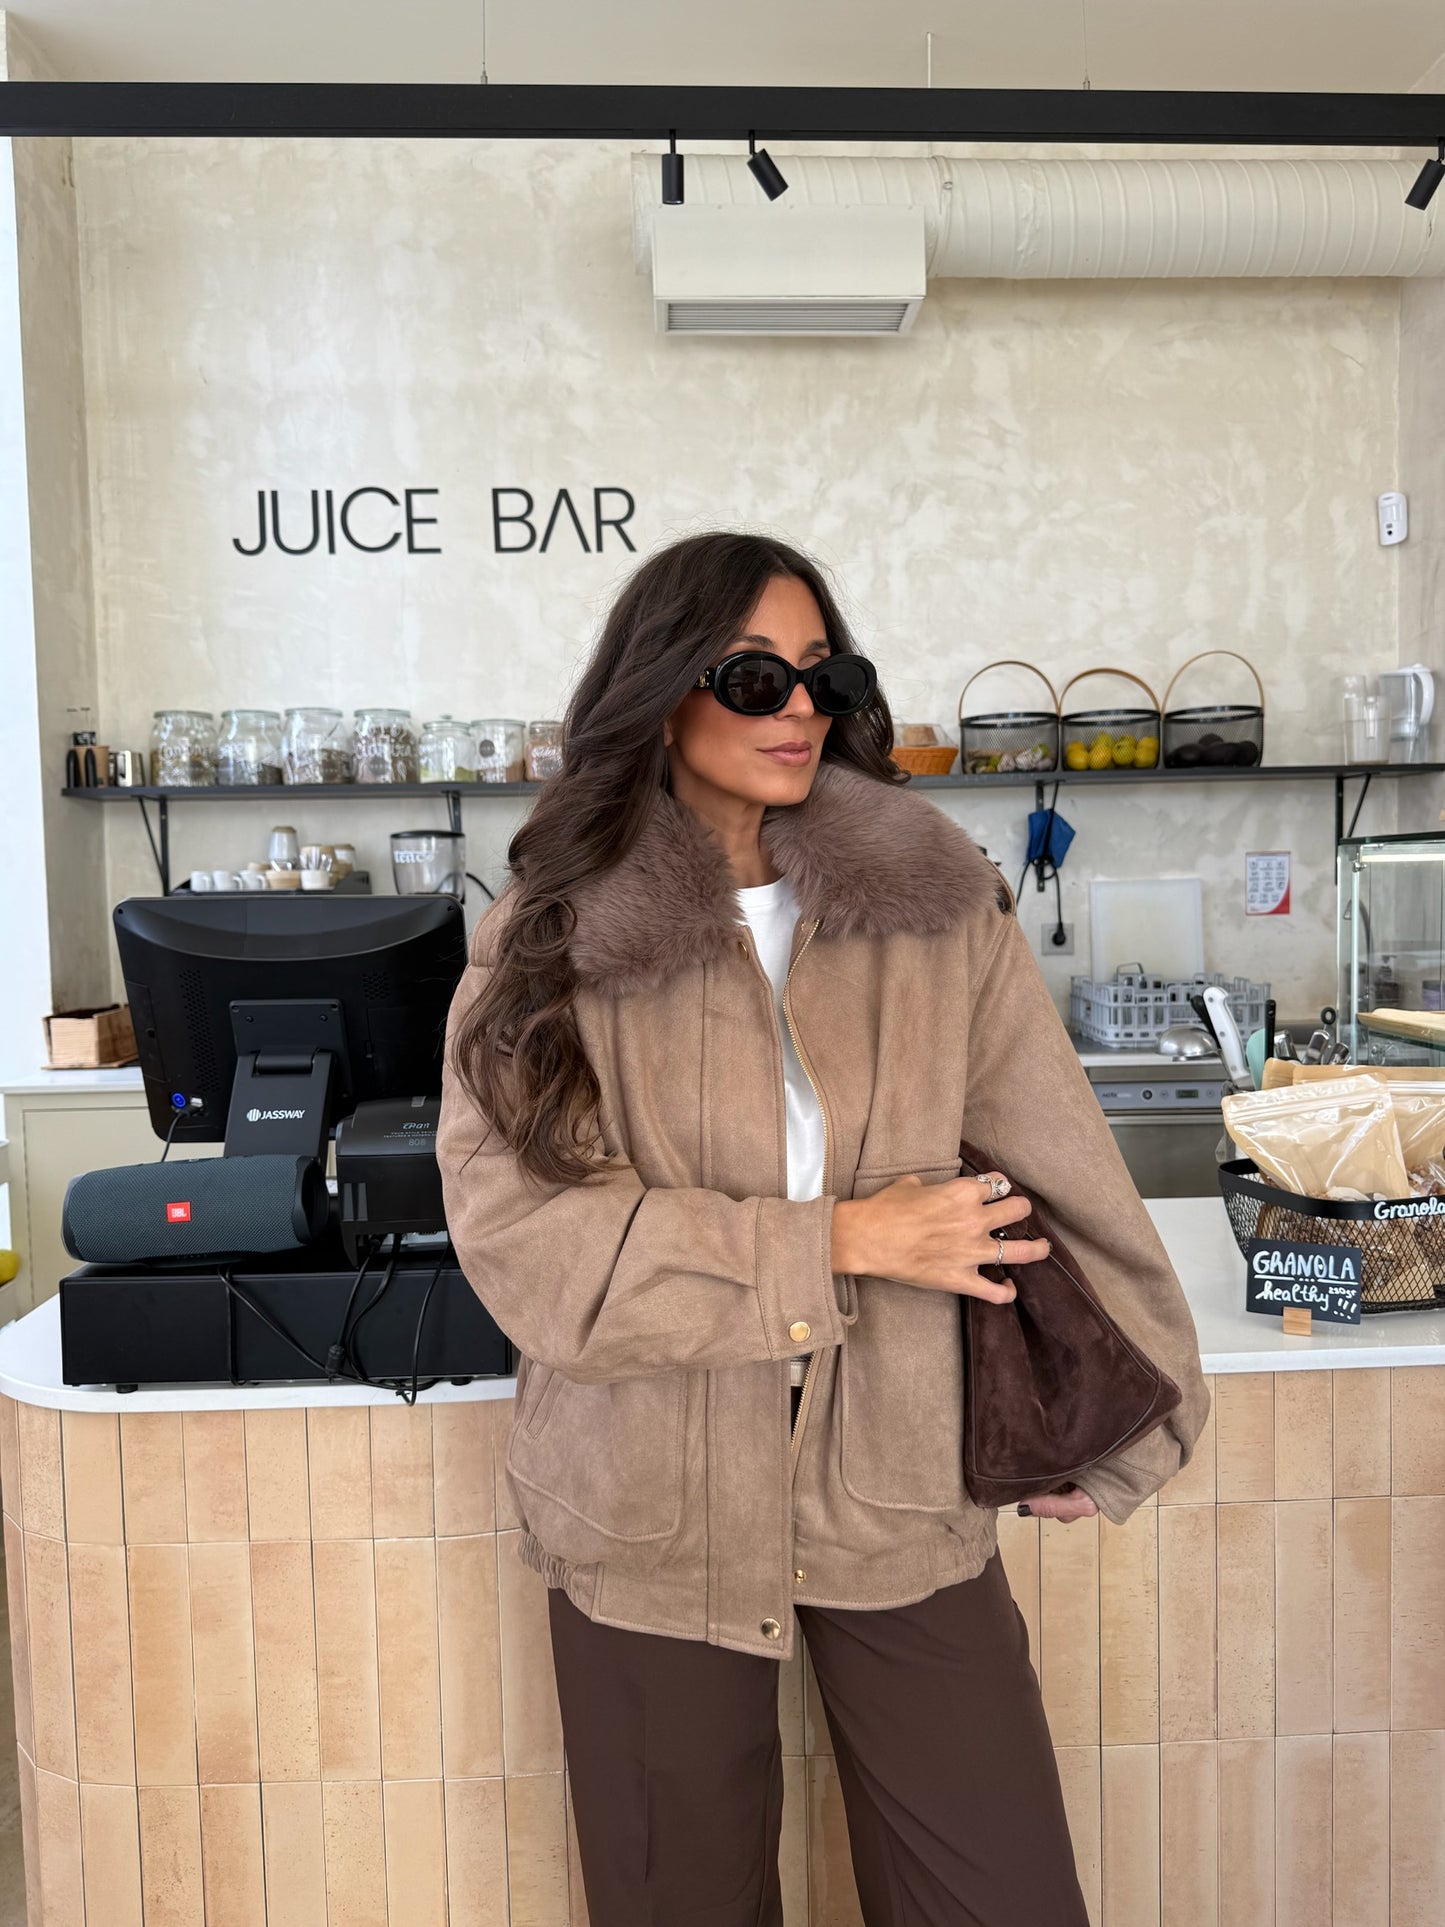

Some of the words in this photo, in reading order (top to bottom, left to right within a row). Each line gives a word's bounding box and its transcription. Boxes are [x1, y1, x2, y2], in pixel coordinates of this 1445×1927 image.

[232, 486, 442, 556] JUICE
[491, 487, 637, 554] BAR
[261, 1109, 306, 1120] JASSWAY
[171, 1207, 187, 1218] JBL
[1373, 1196, 1445, 1220] Granola
[1252, 1250, 1356, 1280] GRANOLA
[1255, 1280, 1330, 1312] healthy
